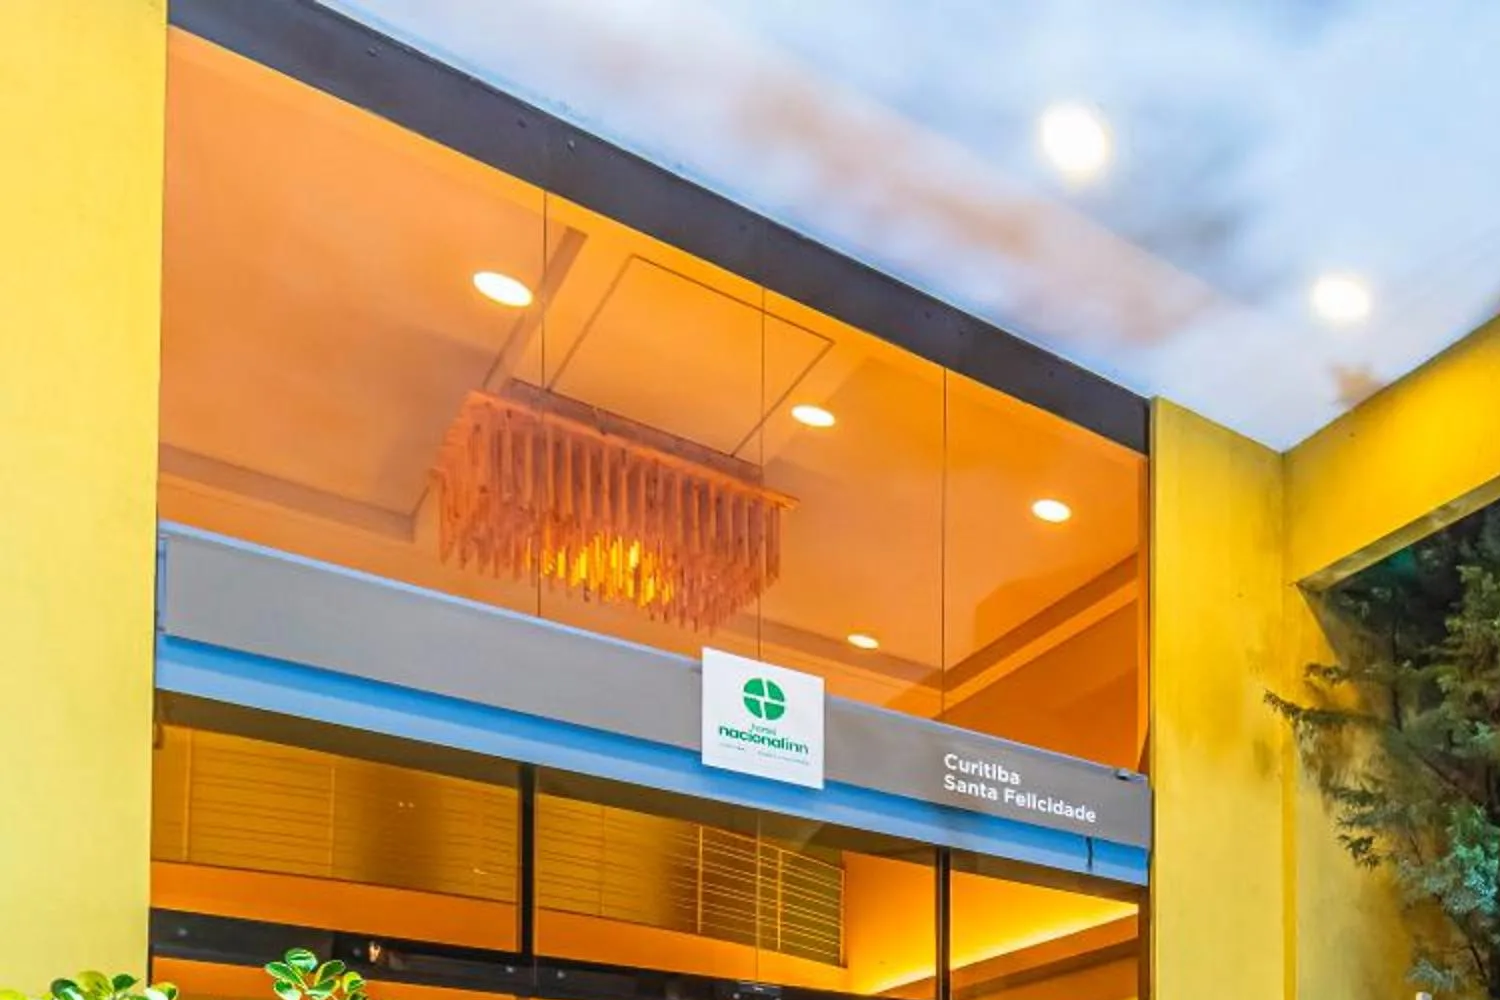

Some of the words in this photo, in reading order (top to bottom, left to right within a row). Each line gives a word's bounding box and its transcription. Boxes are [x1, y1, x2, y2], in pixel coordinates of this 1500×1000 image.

[944, 753, 1021, 785] Curitiba
[944, 774, 998, 801] Santa
[1004, 787, 1097, 823] Felicidade
